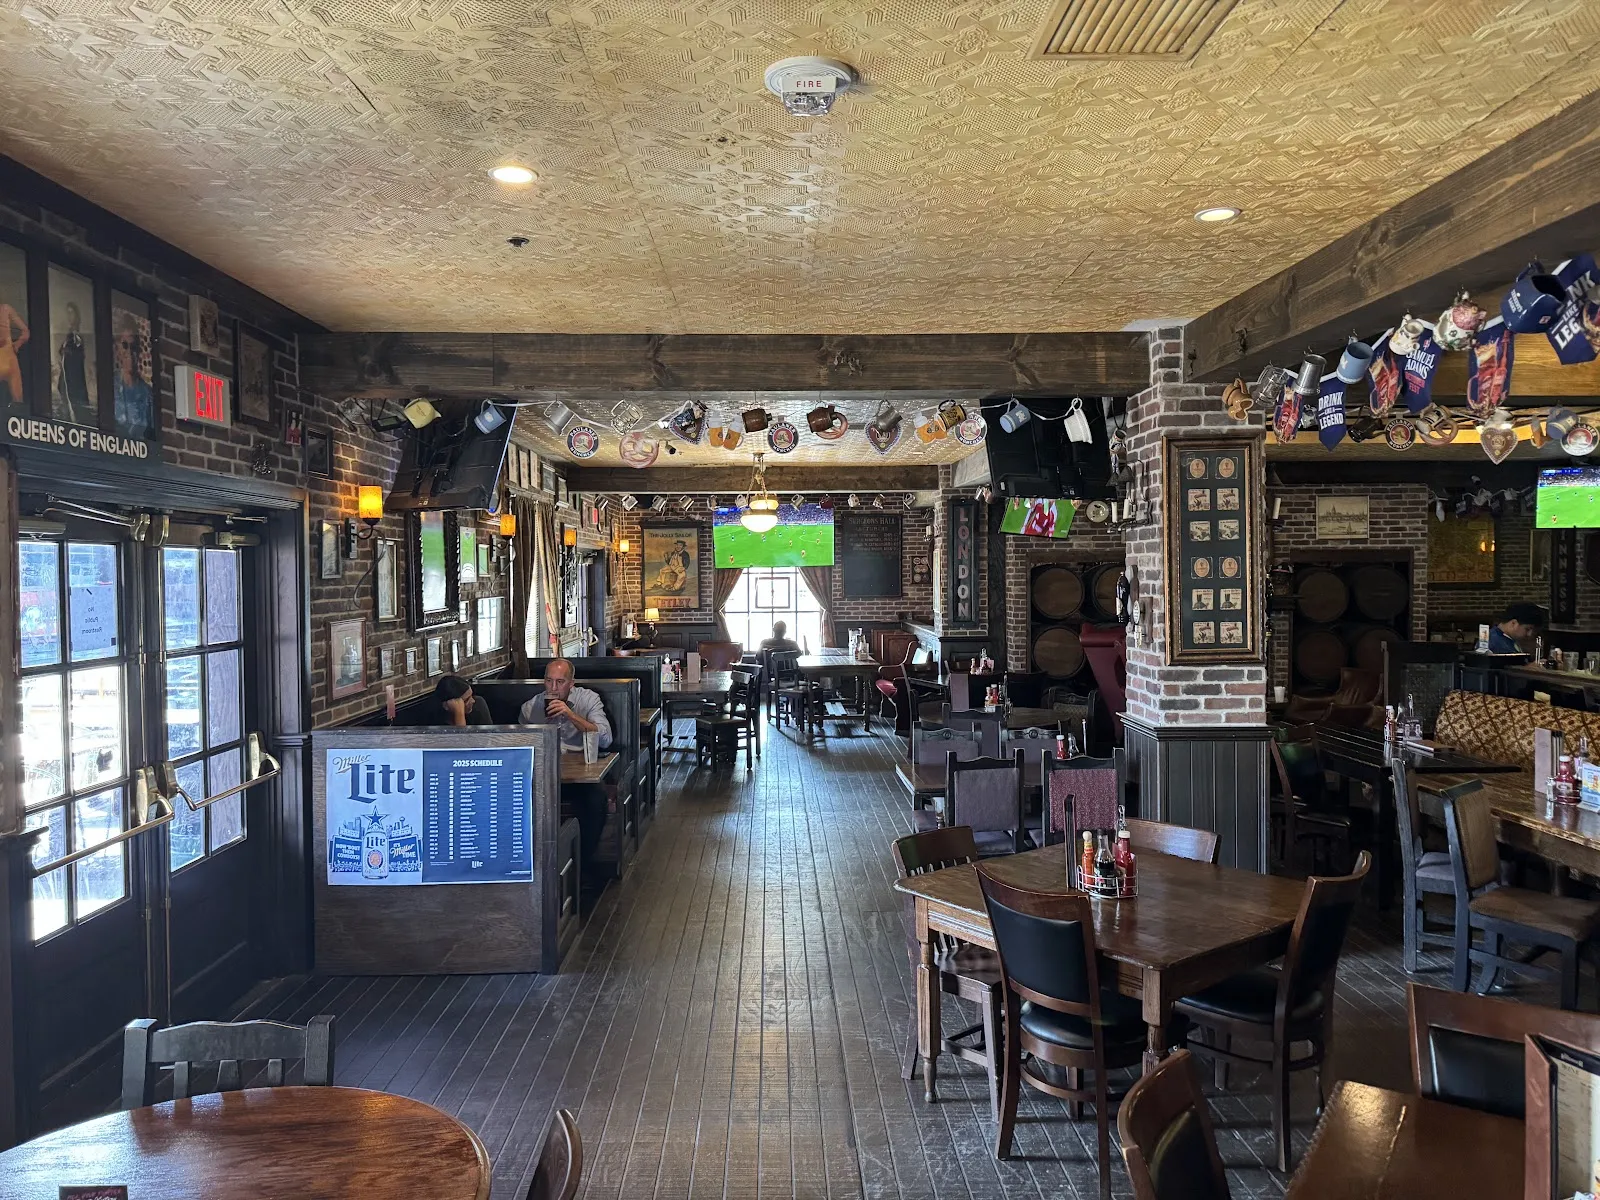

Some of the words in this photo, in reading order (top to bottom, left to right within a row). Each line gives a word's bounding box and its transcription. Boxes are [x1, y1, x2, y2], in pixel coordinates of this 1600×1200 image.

[796, 80, 822, 88] FIRE
[1562, 303, 1579, 323] LIKE
[1554, 317, 1581, 350] LEG
[1404, 358, 1430, 380] ADAMS
[194, 371, 224, 422] EXIT
[1318, 391, 1344, 412] DRINK
[769, 422, 796, 436] PAULANER
[1319, 413, 1344, 430] LEGEND
[1386, 419, 1414, 431] PAULANER
[7, 416, 66, 445] QUEENS
[68, 428, 87, 448] OF
[90, 431, 148, 459] ENGLAND
[569, 426, 597, 440] PAULANER
[957, 508, 969, 618] LONDON
[1558, 529, 1569, 613] INNESS
[653, 598, 691, 608] TETLEY
[332, 754, 371, 774] Miller
[453, 760, 469, 768] 2025
[470, 760, 503, 768] SCHEDULE
[347, 763, 416, 804] Lite
[366, 836, 386, 849] Lite
[390, 843, 416, 858] Miller
